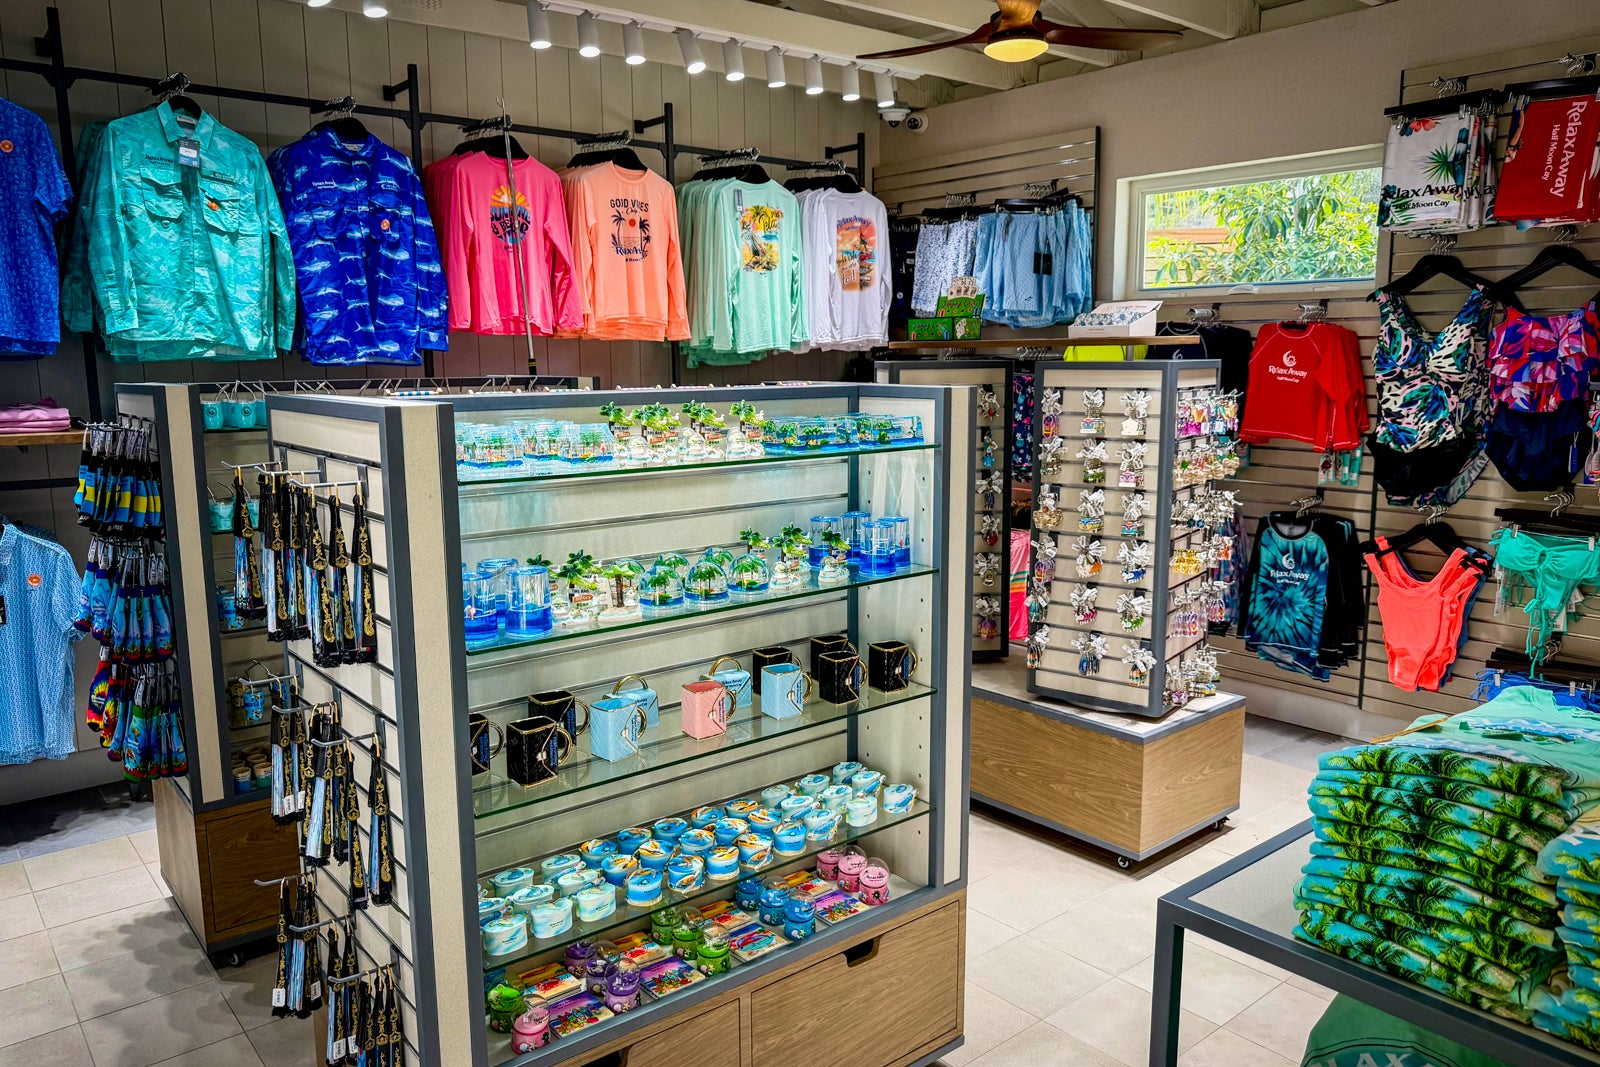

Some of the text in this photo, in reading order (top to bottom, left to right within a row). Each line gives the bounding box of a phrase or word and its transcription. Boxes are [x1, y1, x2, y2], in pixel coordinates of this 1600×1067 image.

[1541, 124, 1561, 181] Half Moon Cay
[1411, 200, 1433, 210] Moon
[1434, 199, 1451, 207] Cay
